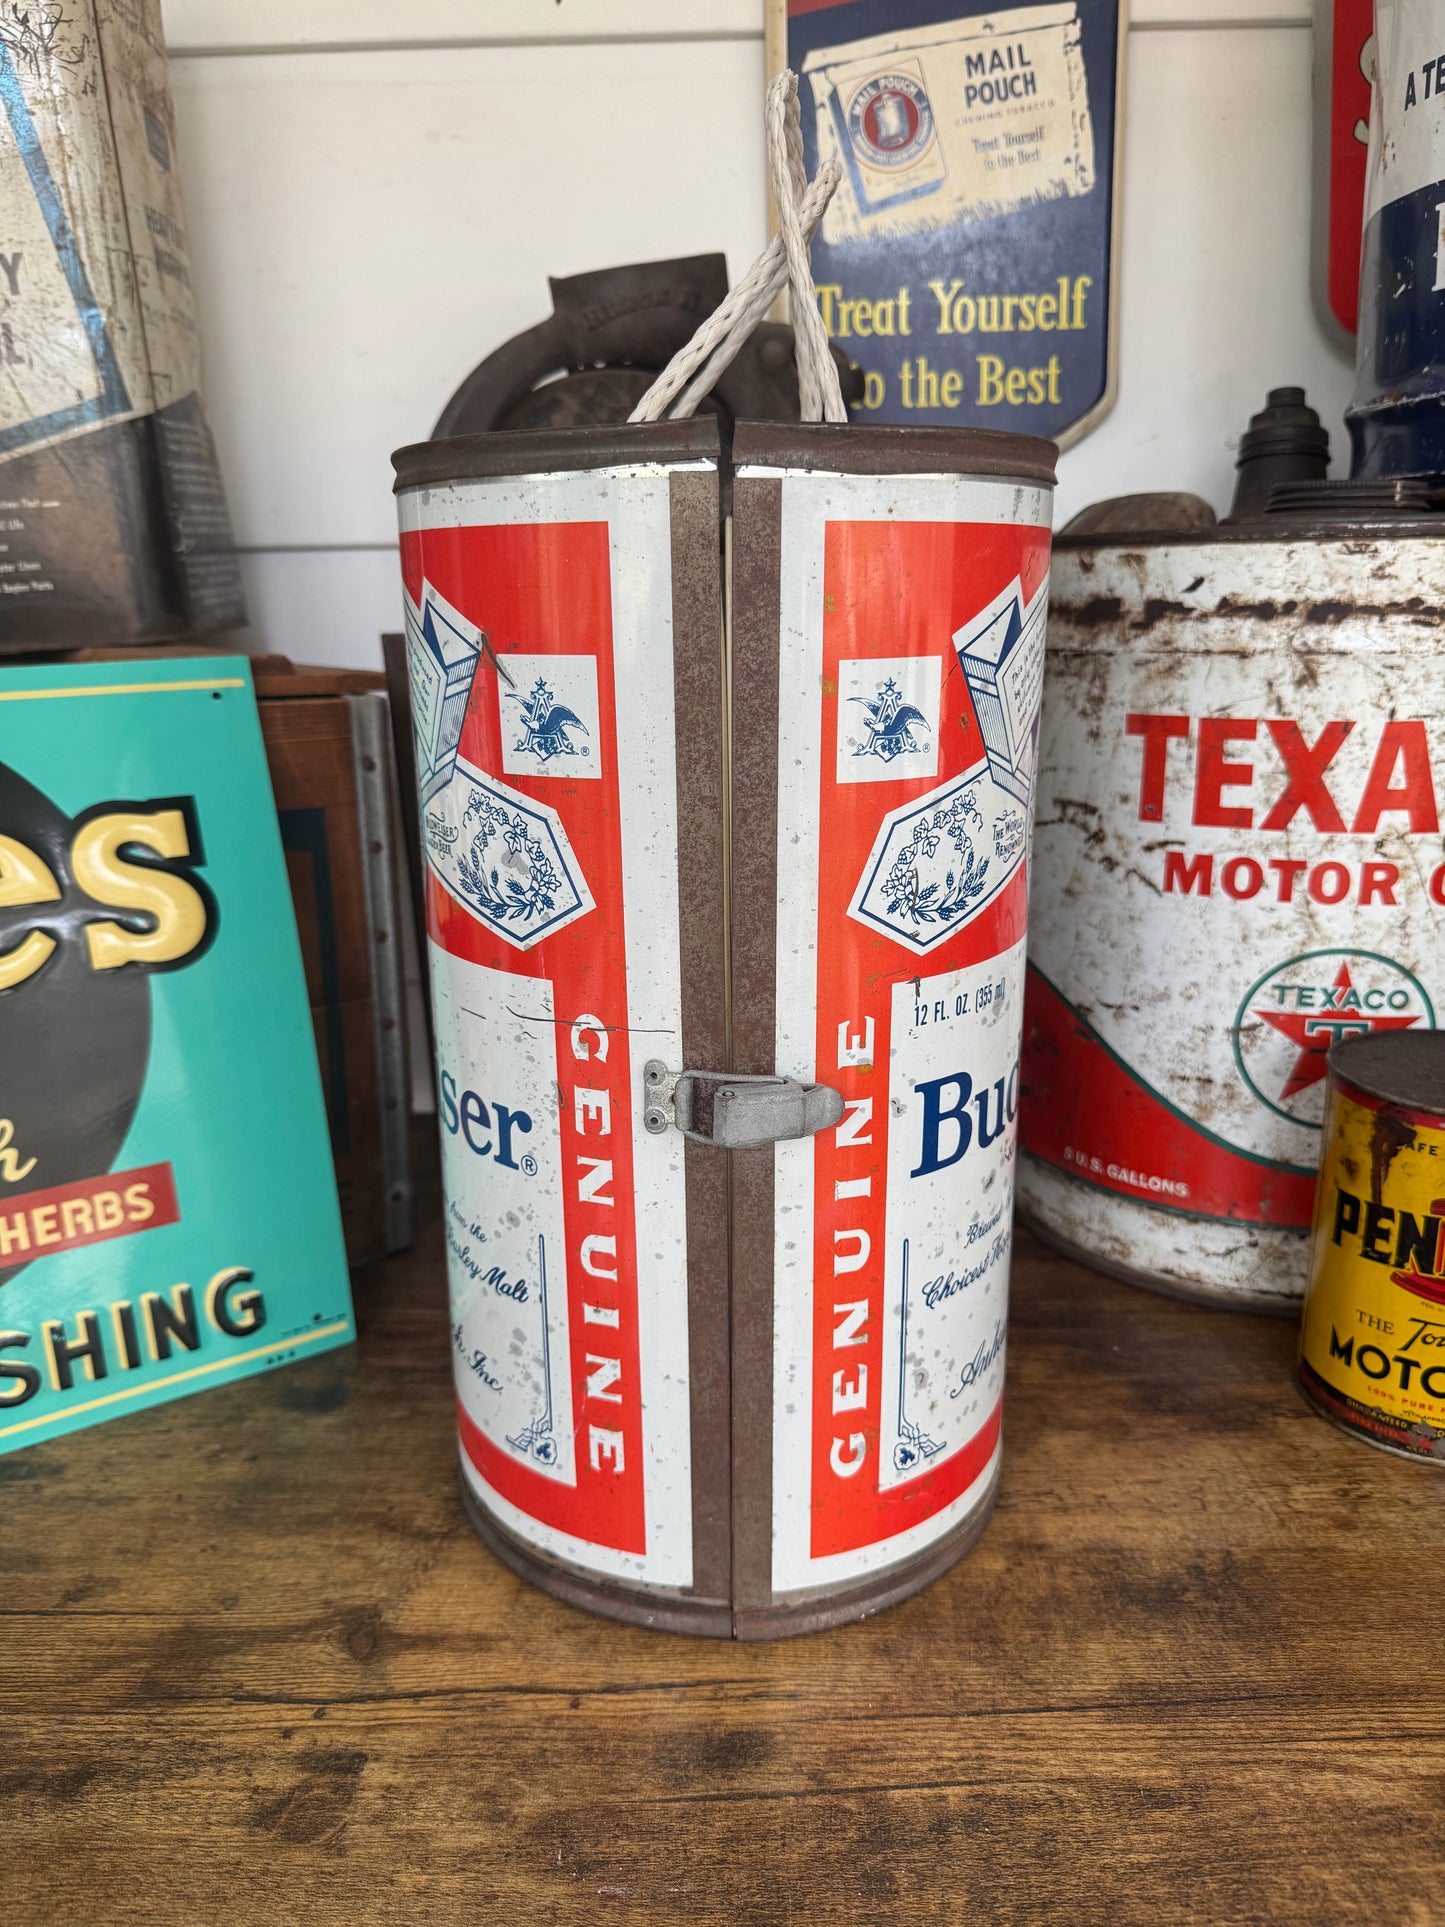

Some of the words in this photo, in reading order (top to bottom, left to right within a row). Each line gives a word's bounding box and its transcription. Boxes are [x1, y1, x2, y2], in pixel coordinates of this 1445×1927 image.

[965, 43, 1031, 79] MAIL
[964, 72, 1037, 109] POUCH
[1404, 71, 1416, 112] A
[971, 136, 1000, 153] Treat
[1003, 125, 1045, 149] Yourself
[997, 150, 1015, 169] the
[1017, 147, 1041, 165] Best
[816, 282, 912, 338] Treat
[928, 275, 1093, 335] Yourself
[851, 362, 885, 410] o
[901, 356, 964, 407] the
[975, 353, 1063, 406] Best
[1125, 713, 1440, 834] TEXA
[1162, 850, 1400, 906] MOTOR
[914, 1003, 928, 1027] 12
[934, 1000, 949, 1022] FL.
[955, 993, 971, 1016] OZ.
[975, 984, 992, 1013] (355
[1271, 984, 1410, 1011] TEXACO
[1106, 1163, 1191, 1198] GALLONS
[0, 1183, 155, 1256] HERBS
[470, 1223, 488, 1243] the
[570, 1013, 625, 1473] GENUINE
[829, 1015, 876, 1479] GENUINE
[480, 1266, 529, 1303] Malt
[921, 1251, 989, 1309] Choicest
[1355, 1308, 1395, 1335] THE
[468, 1349, 503, 1395] Inc.
[1367, 1385, 1395, 1401] 100%
[1401, 1397, 1434, 1411] PURE
